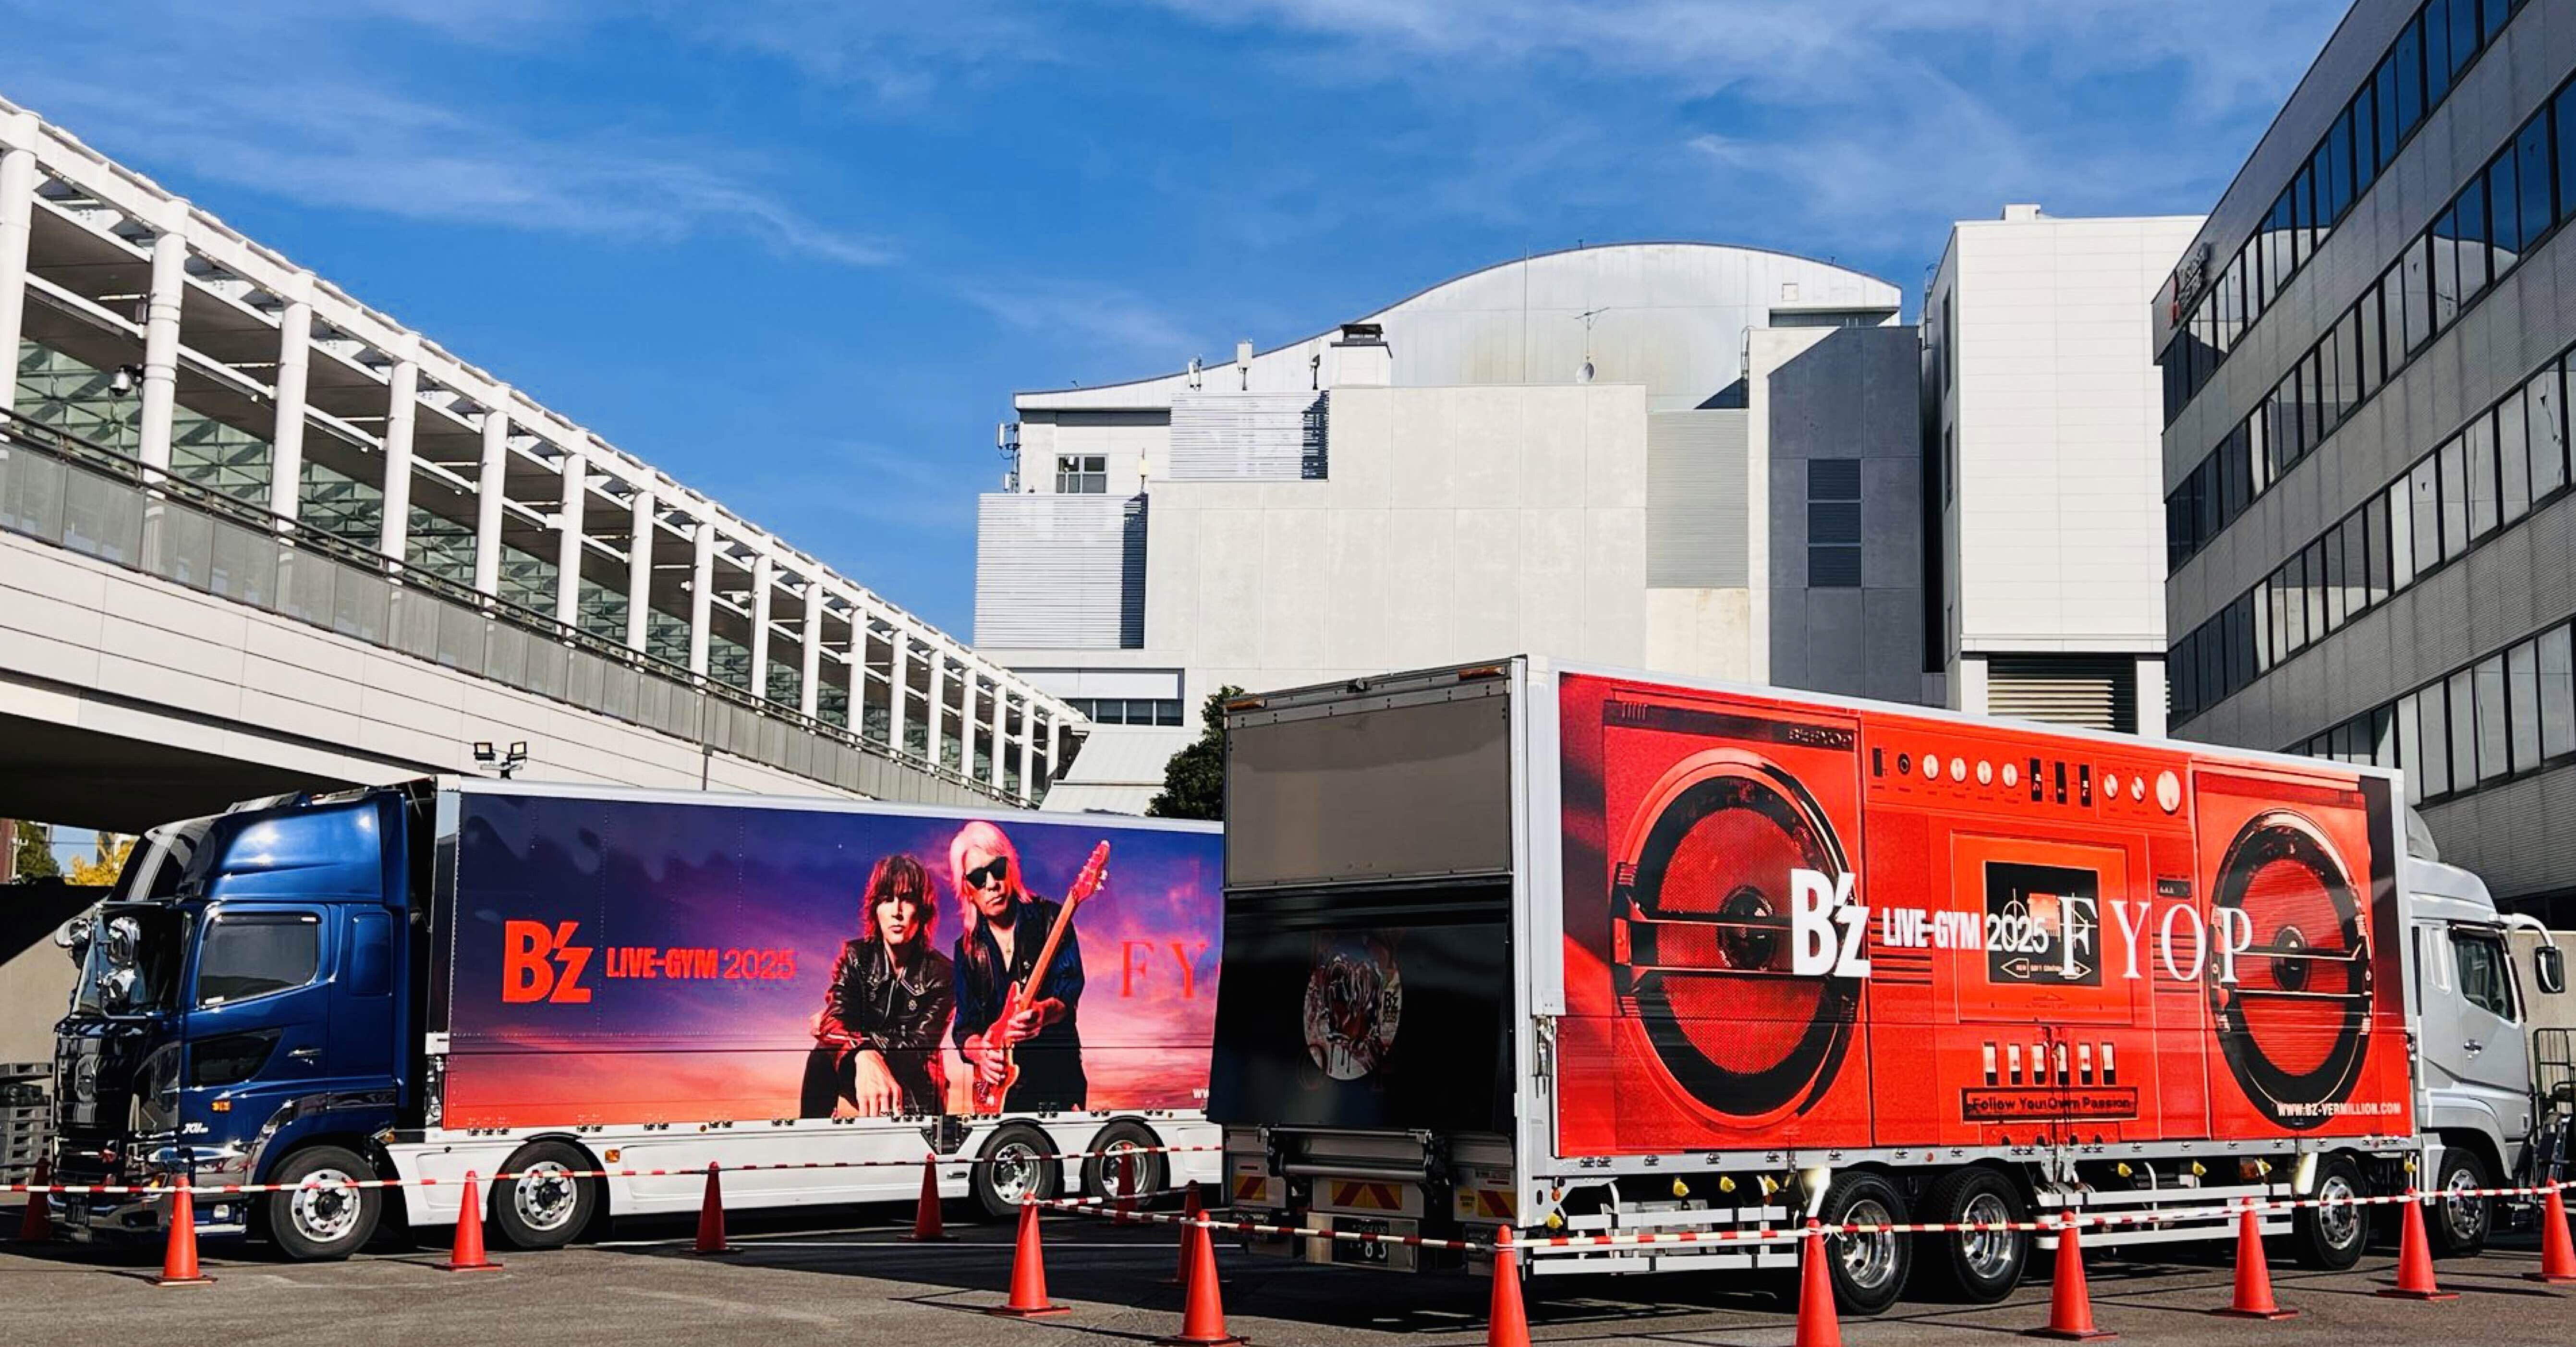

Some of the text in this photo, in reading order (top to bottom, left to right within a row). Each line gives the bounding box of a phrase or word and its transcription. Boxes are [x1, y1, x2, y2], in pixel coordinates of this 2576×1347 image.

[1791, 869, 2252, 983] B'z LIVE-GYM 2025 FYOP
[502, 921, 798, 1003] B'z LIVE-GYM 2025
[1121, 940, 1221, 998] FY
[1972, 1097, 2016, 1110] Follow
[2082, 1096, 2130, 1109] Passion
